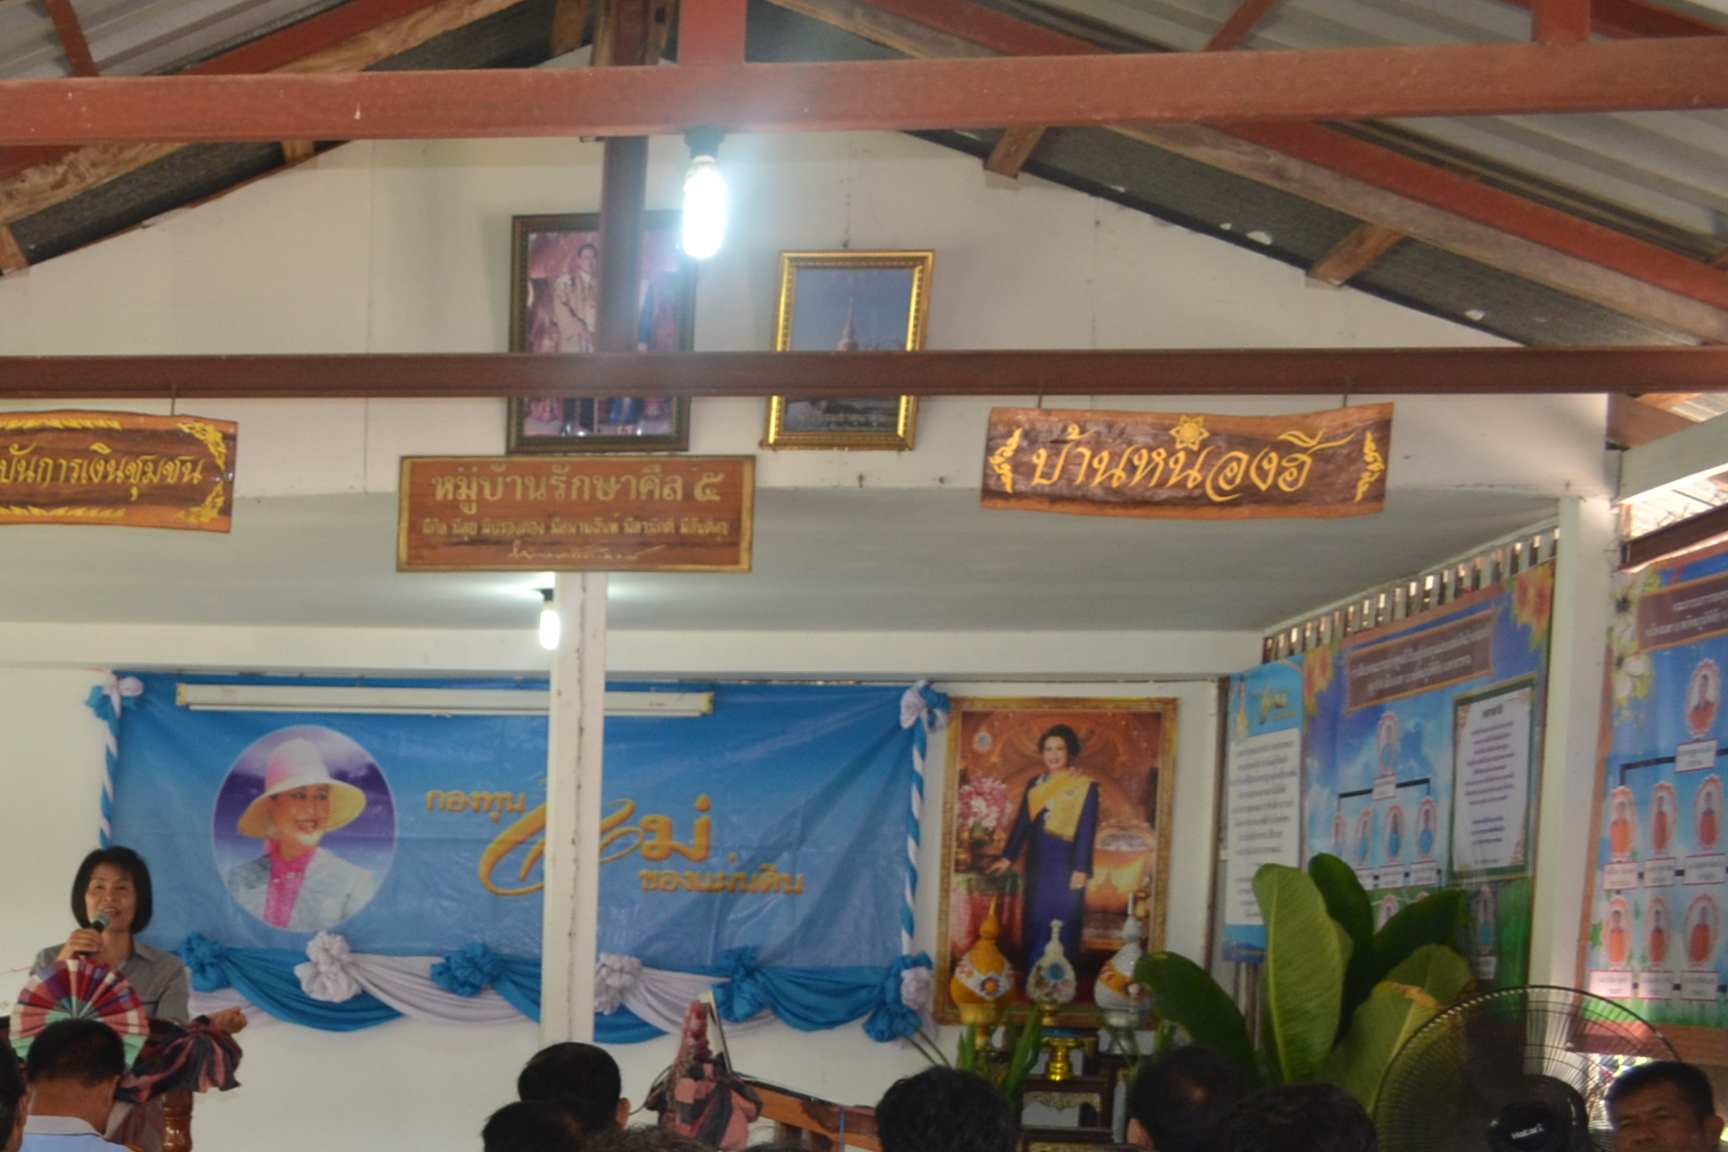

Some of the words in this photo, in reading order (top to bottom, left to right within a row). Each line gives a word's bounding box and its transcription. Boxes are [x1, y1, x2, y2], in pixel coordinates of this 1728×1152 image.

[431, 462, 685, 514] หมู่บ้านรักษาศีล
[693, 472, 726, 502] ๕
[1031, 422, 1355, 501] บ้านหนองฮี
